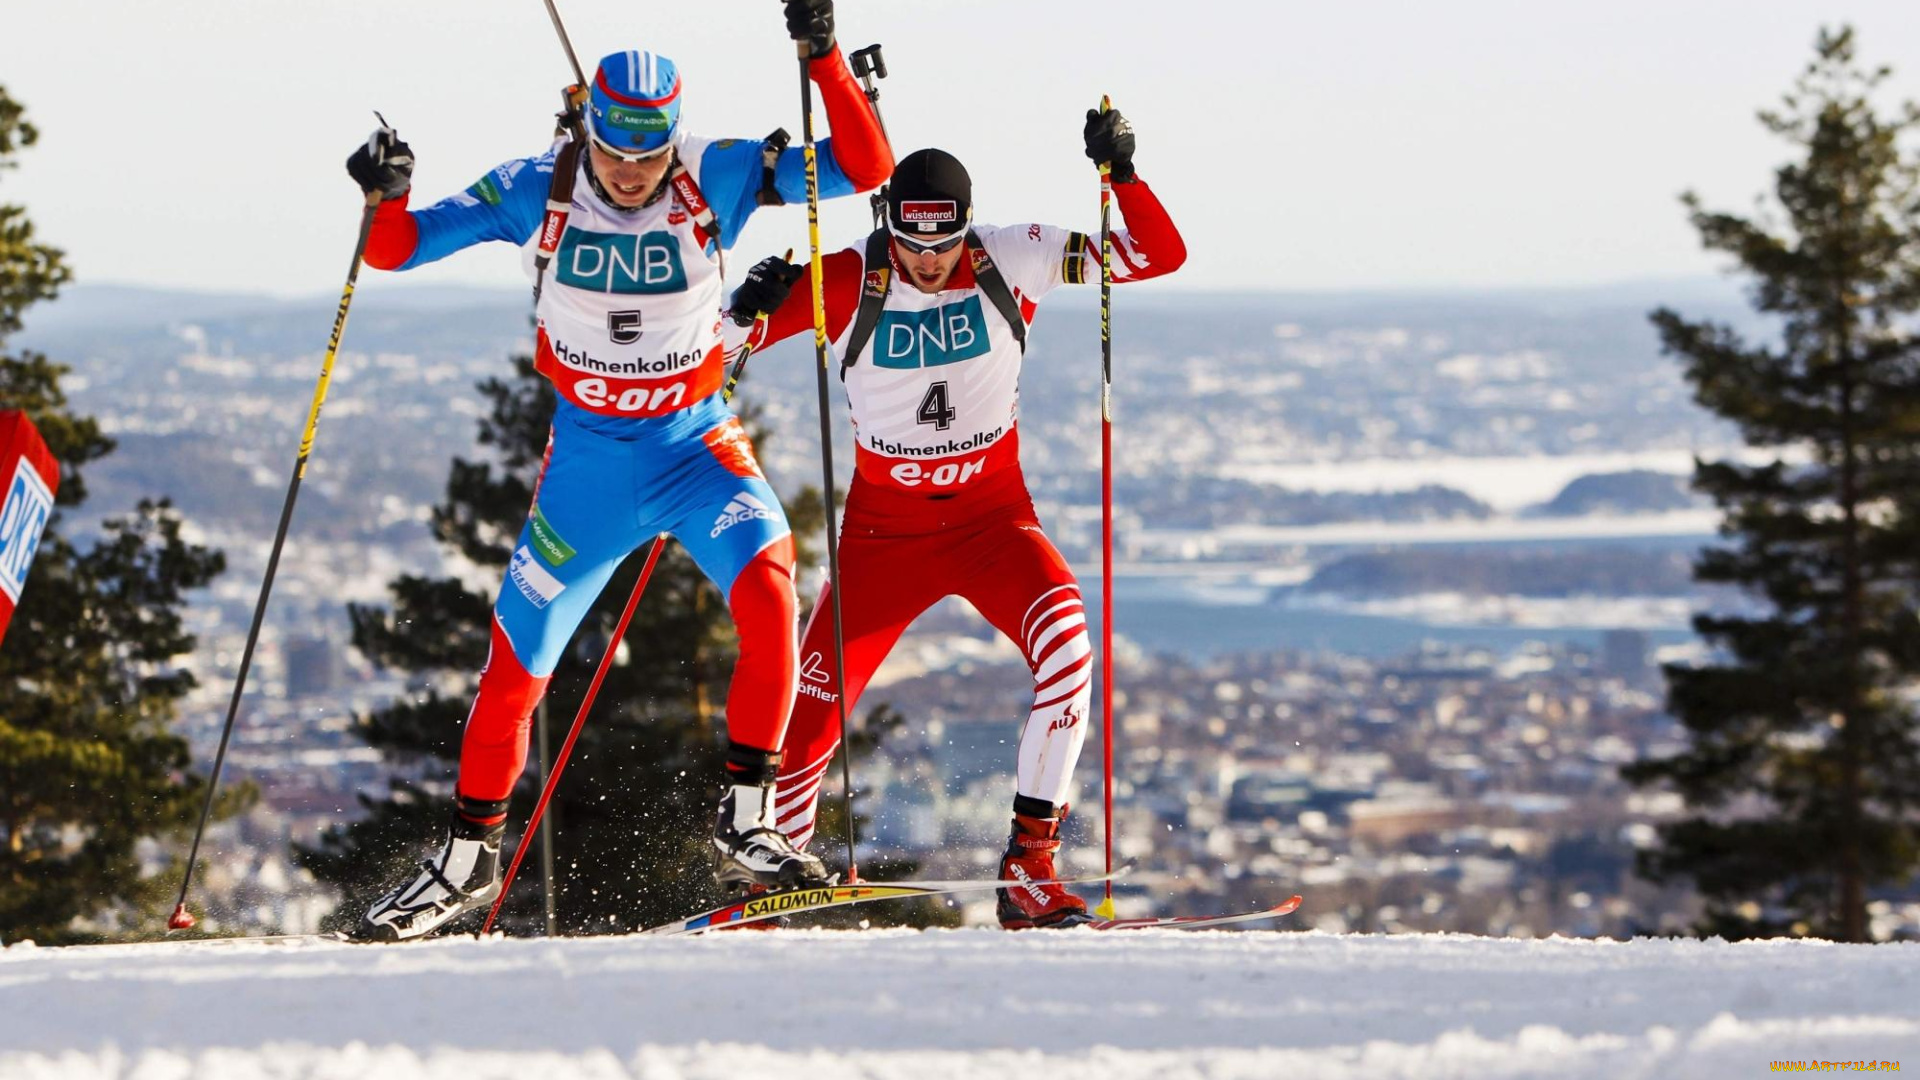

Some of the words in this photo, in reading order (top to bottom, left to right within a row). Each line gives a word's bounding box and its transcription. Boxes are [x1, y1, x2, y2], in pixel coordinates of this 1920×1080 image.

[905, 209, 953, 220] wüstenrot
[572, 233, 673, 293] DNB
[607, 310, 643, 345] 5
[887, 305, 976, 368] DNB
[555, 340, 702, 374] Holmenkollen
[916, 380, 956, 432] 4
[871, 426, 1003, 456] Holmenkollen
[710, 508, 781, 539] adidas
[746, 889, 834, 918] SALOMON
